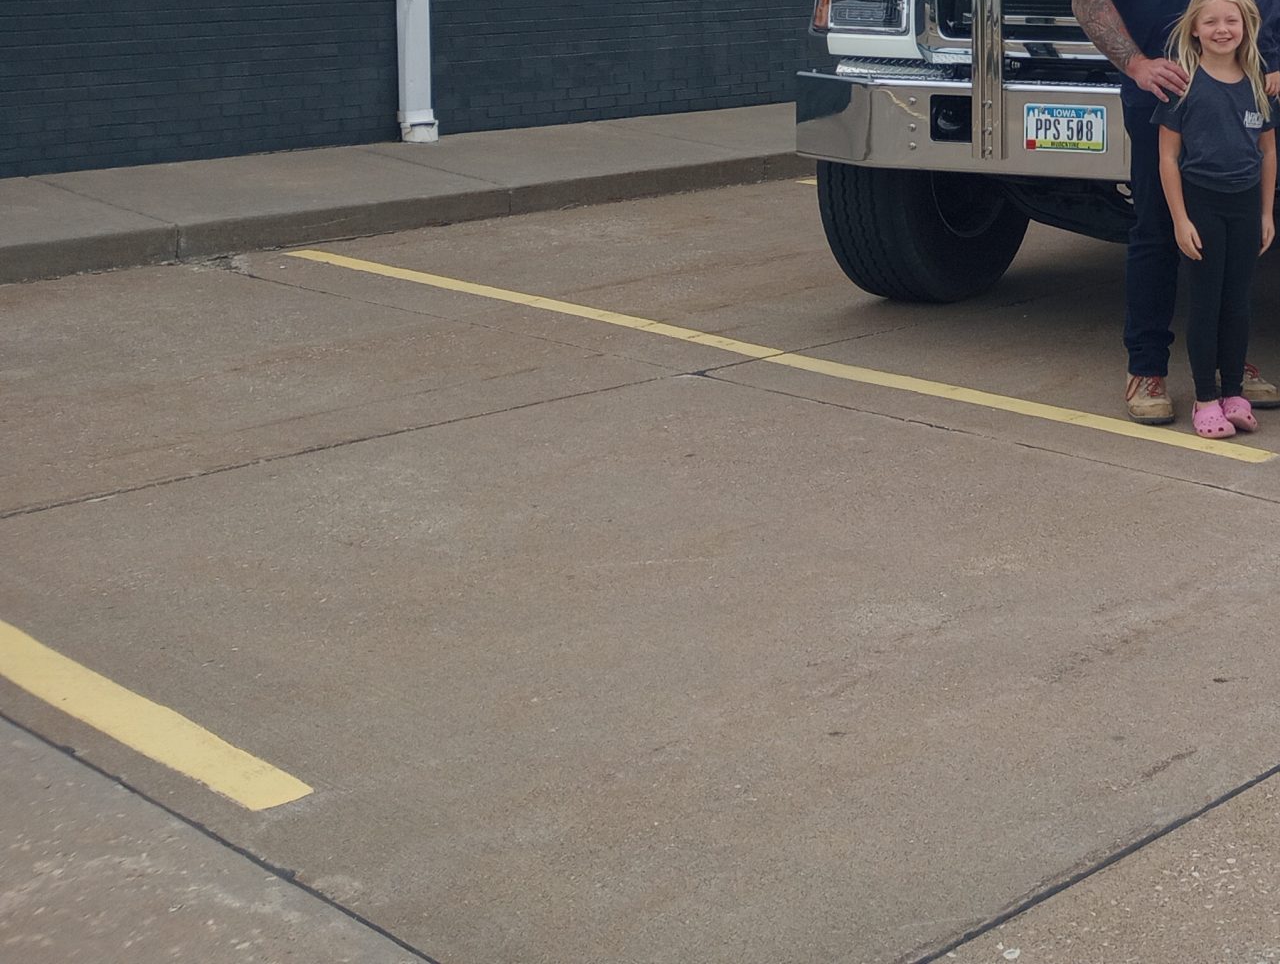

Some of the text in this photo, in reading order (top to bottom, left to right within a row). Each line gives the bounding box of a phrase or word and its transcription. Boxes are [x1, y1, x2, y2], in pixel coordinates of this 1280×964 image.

[1053, 108, 1076, 118] IOWA
[1035, 118, 1094, 142] PPS 508
